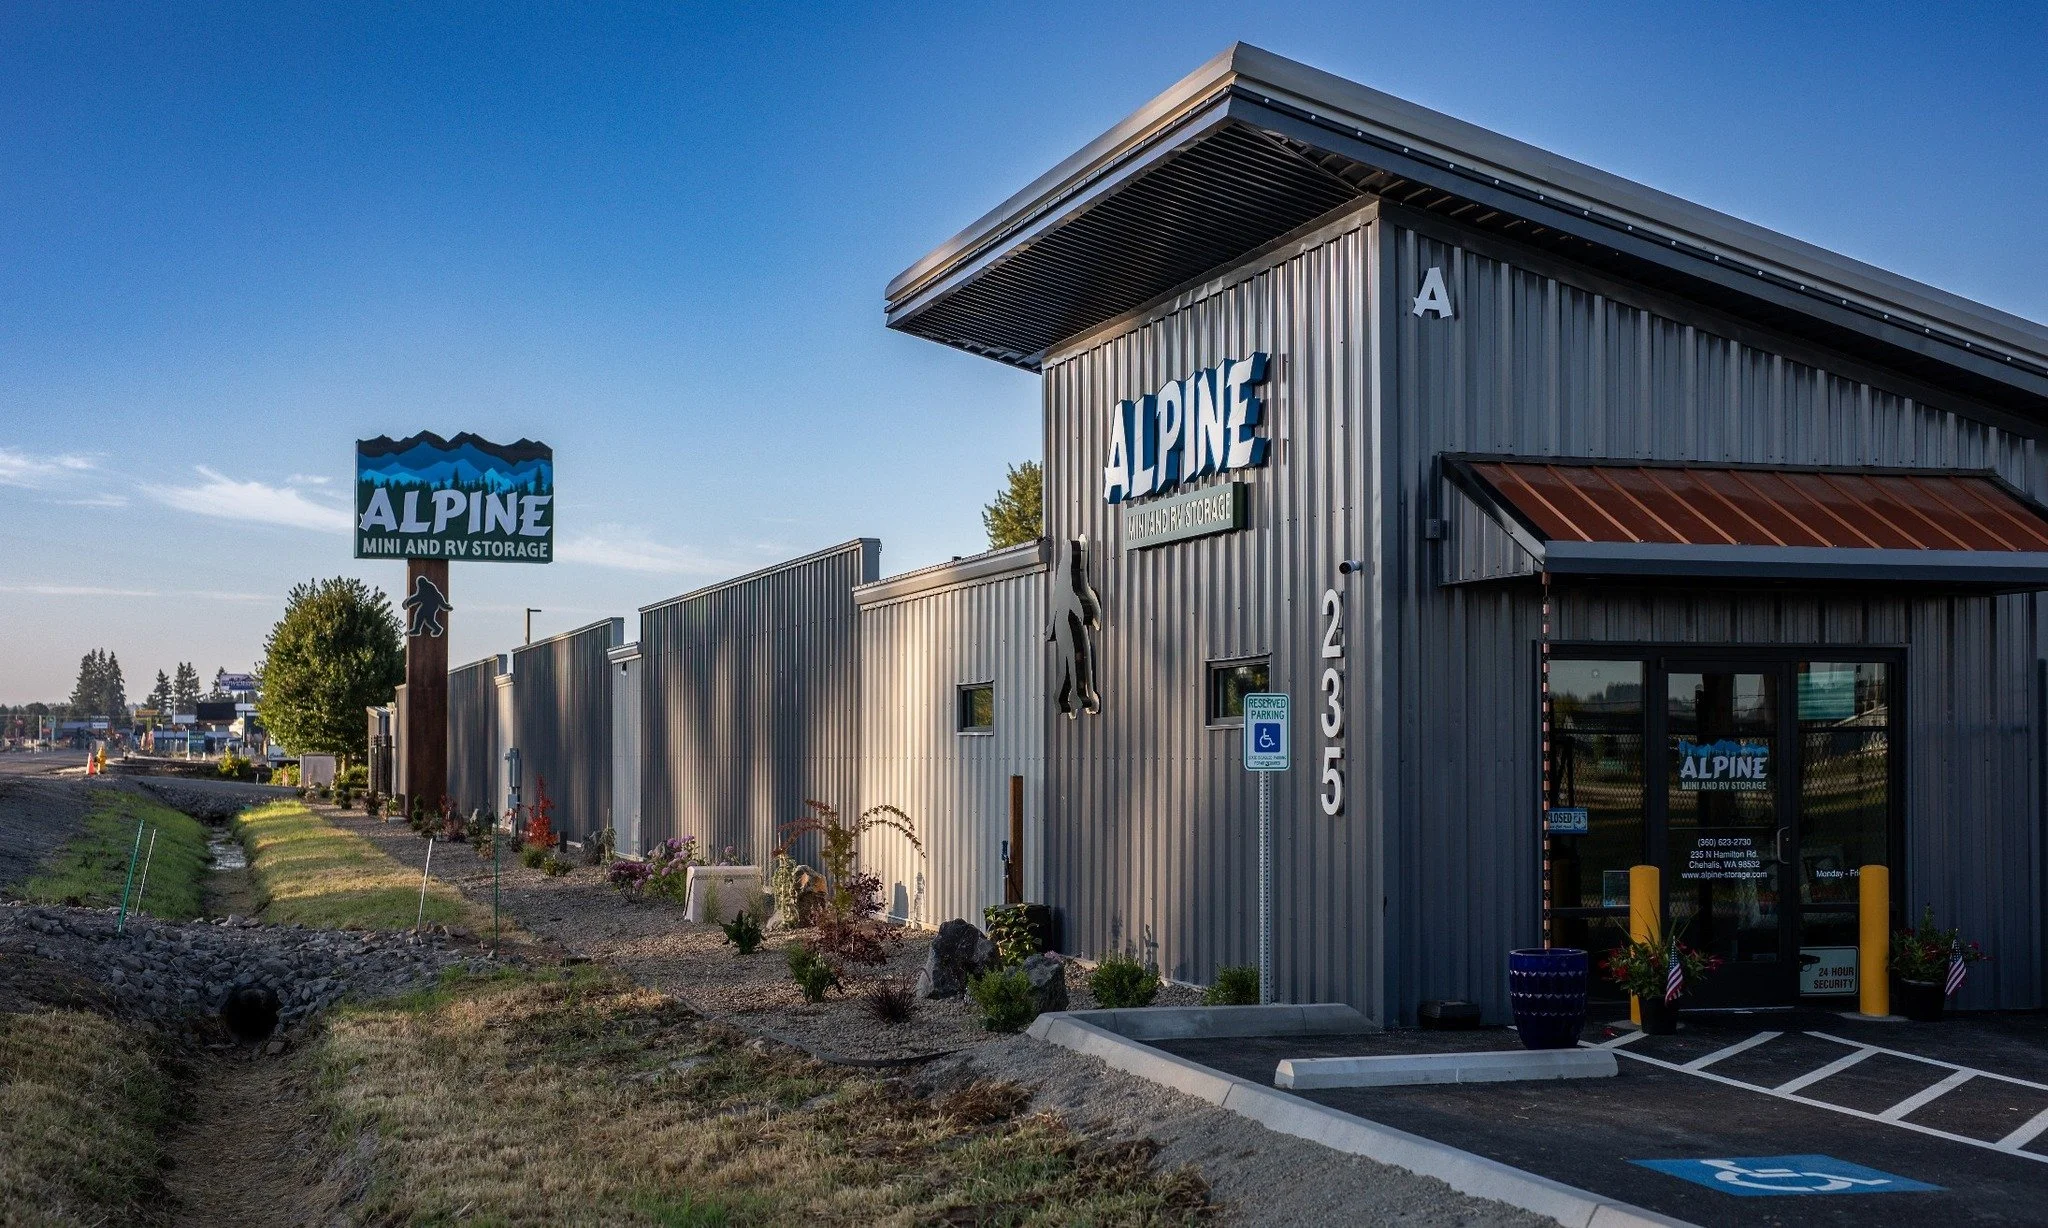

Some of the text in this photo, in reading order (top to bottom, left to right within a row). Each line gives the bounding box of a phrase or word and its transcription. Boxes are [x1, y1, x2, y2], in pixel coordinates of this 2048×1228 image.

[1412, 267, 1453, 319] A
[1103, 352, 1268, 505] ALPINE
[359, 487, 553, 536] ALPINE
[1128, 492, 1231, 541] MINI AND RV STORAGE
[363, 537, 549, 558] MINI AND RV STORAGE
[1248, 698, 1287, 709] RESERVED
[1320, 588, 1343, 816] 235
[1251, 710, 1285, 720] PARKING
[1680, 755, 1768, 779] ALPINE
[1681, 781, 1767, 790] MINI AND RV STORAGE
[1548, 812, 1572, 824] LOSED
[1697, 838, 1752, 847] (360) 623-2730
[1690, 849, 1759, 859] 235 N Hamilton Rd.
[1688, 860, 1760, 869] Chehalis, WA 98532
[1681, 871, 1768, 880] www.alpine-storage.com
[1816, 869, 1844, 879] Monday
[1818, 966, 1855, 977] 24 HOUR
[1813, 979, 1854, 989] SECURITY
